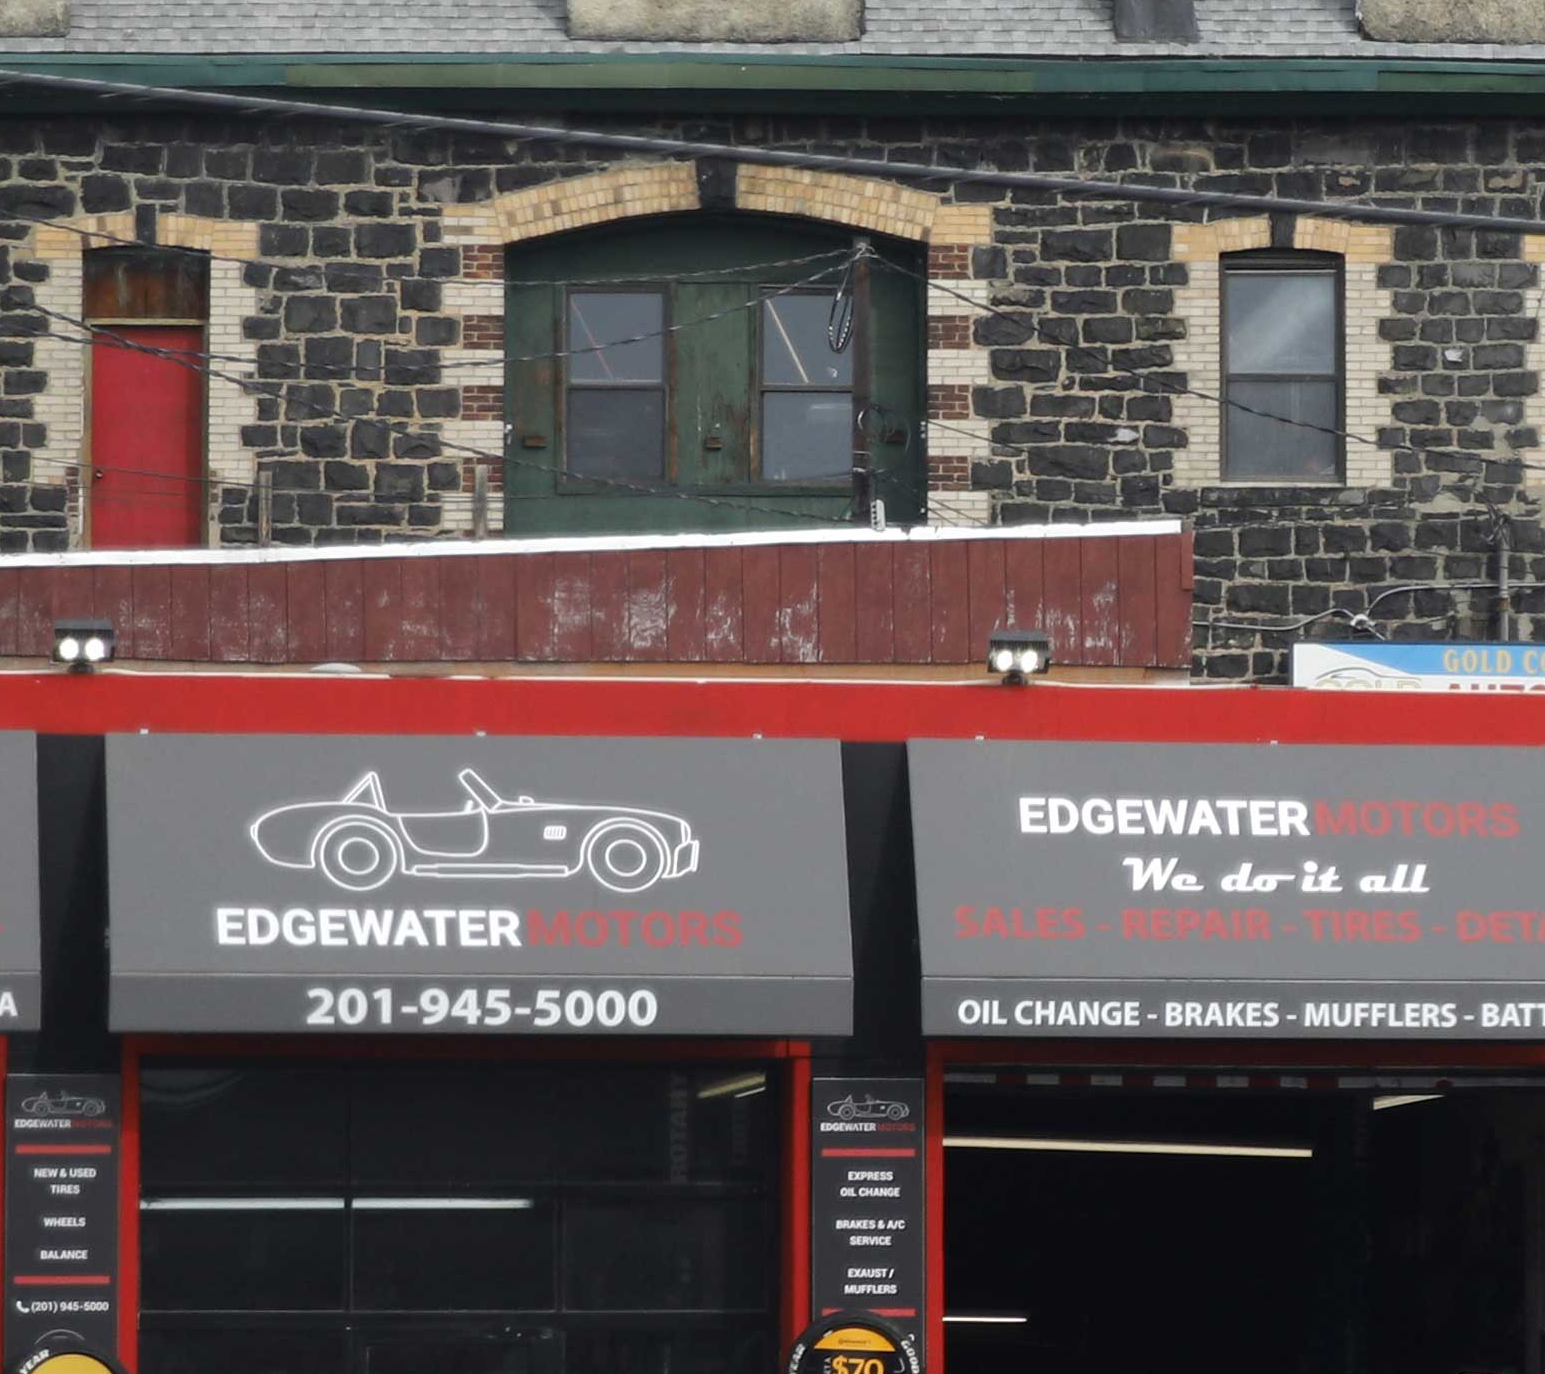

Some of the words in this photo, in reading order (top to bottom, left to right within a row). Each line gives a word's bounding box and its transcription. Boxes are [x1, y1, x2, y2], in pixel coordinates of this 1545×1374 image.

[1443, 649, 1512, 673] GOLD
[1018, 797, 1310, 836] EDGEWATER
[1313, 801, 1521, 838] MOTORS
[1123, 857, 1205, 893] We
[1221, 858, 1294, 894] do
[1299, 861, 1344, 894] it
[1359, 862, 1431, 895] all
[216, 907, 521, 947] EDGEWATER
[526, 910, 744, 948] MOTORS
[953, 906, 1085, 940] SALES
[1121, 907, 1273, 942] REPAIR
[1303, 910, 1422, 943] TIRES
[306, 987, 658, 1027] 201-945-5000
[957, 998, 1007, 1025] OIL
[1013, 999, 1141, 1026] CHANGE
[1164, 1000, 1280, 1027] BRAKES
[1304, 1001, 1458, 1028] MUFFLERS
[14, 1118, 71, 1129] EDGEWATER
[820, 1122, 876, 1132] EDGEWATER
[34, 1167, 58, 1178] NEW
[59, 1167, 67, 1178] &
[69, 1168, 97, 1179] USED
[847, 1171, 894, 1181] EXPRESS
[50, 1184, 81, 1195] TIRES
[840, 1187, 857, 1198] OIL
[858, 1187, 901, 1198] CHANGE
[43, 1217, 87, 1228] WHEELS
[835, 1219, 876, 1230] BRAKES
[877, 1220, 886, 1230] &
[887, 1220, 906, 1230] A/C
[849, 1236, 892, 1246] SERVICE
[40, 1249, 88, 1260] BALANCE
[847, 1268, 887, 1279] EXAUST
[844, 1284, 898, 1295] MUFFLERS
[31, 1300, 59, 1313] (201)
[60, 1301, 110, 1312] 945-5000
